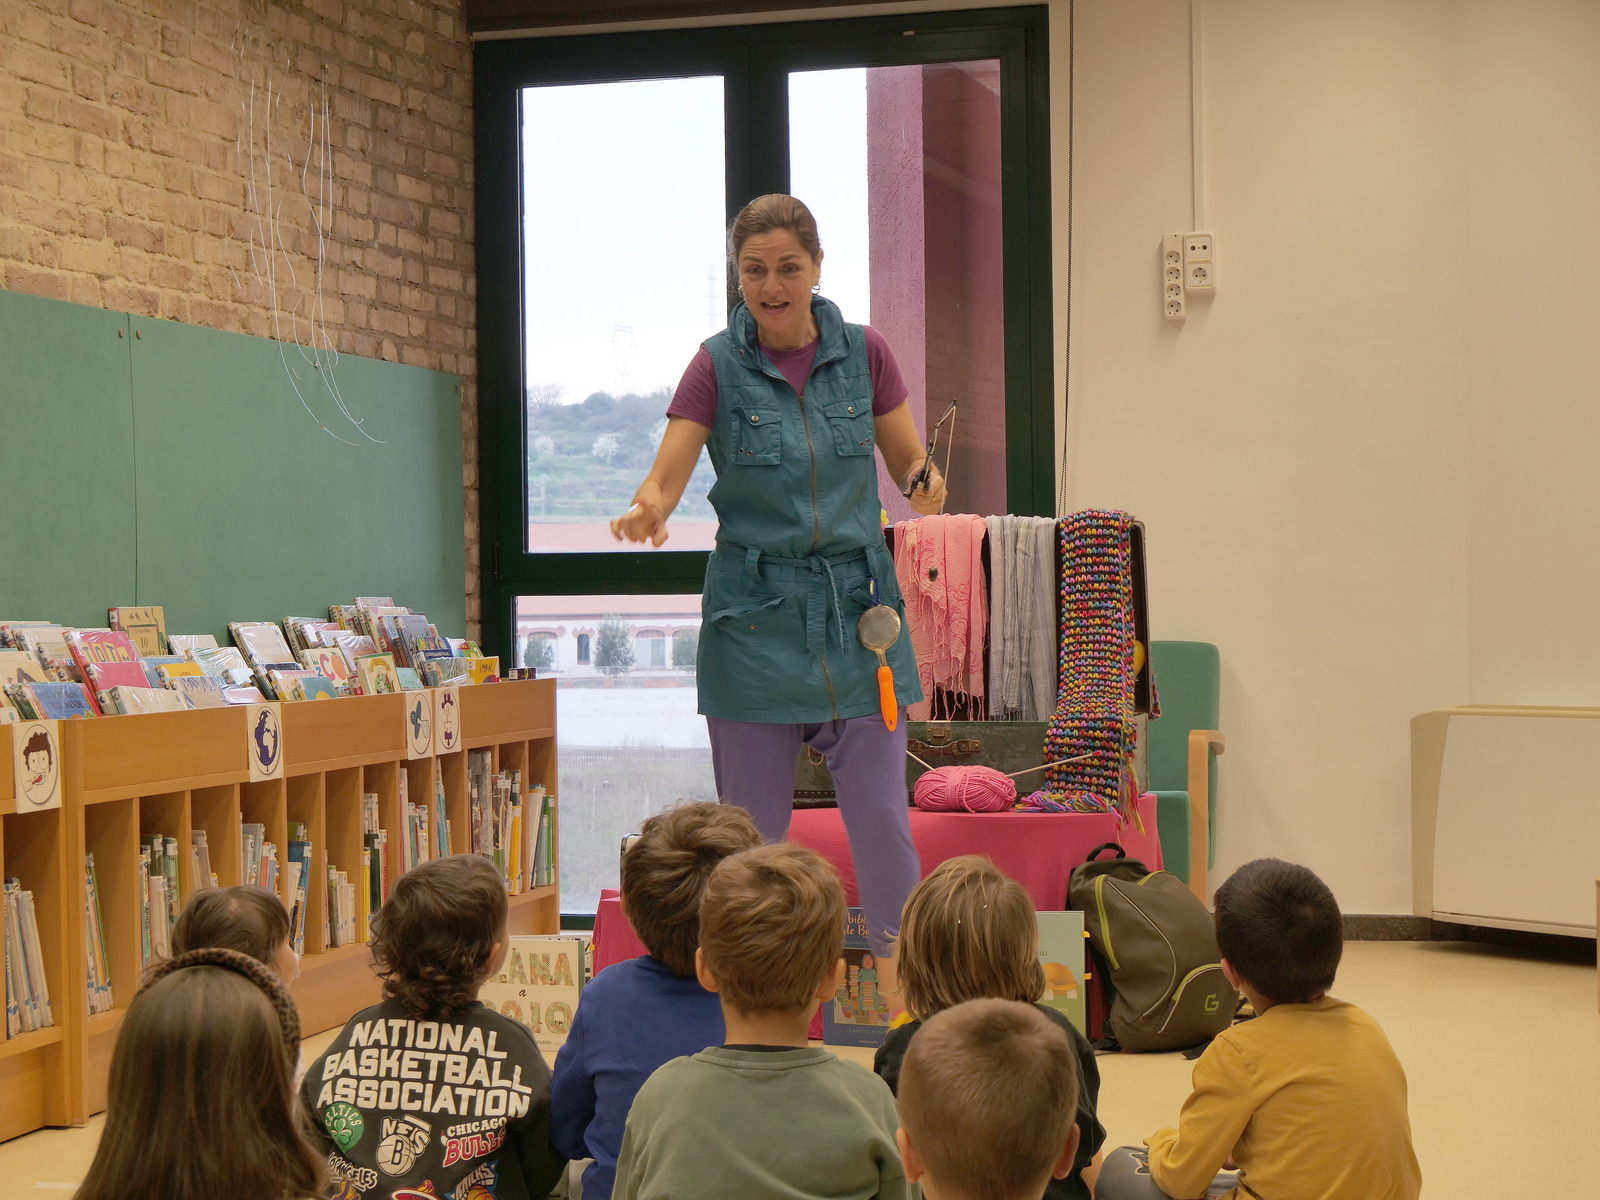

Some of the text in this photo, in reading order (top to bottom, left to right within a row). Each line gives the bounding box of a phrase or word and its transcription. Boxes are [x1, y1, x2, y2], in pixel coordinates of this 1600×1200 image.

[140, 637, 149, 649] 10
[348, 1018, 508, 1059] NATIONAL
[321, 1048, 533, 1094] BASKETBALL
[316, 1078, 531, 1118] ASSOCIATION
[325, 1104, 363, 1127] CELTICS
[446, 1117, 507, 1138] CHICAGO
[391, 1139, 405, 1165] B
